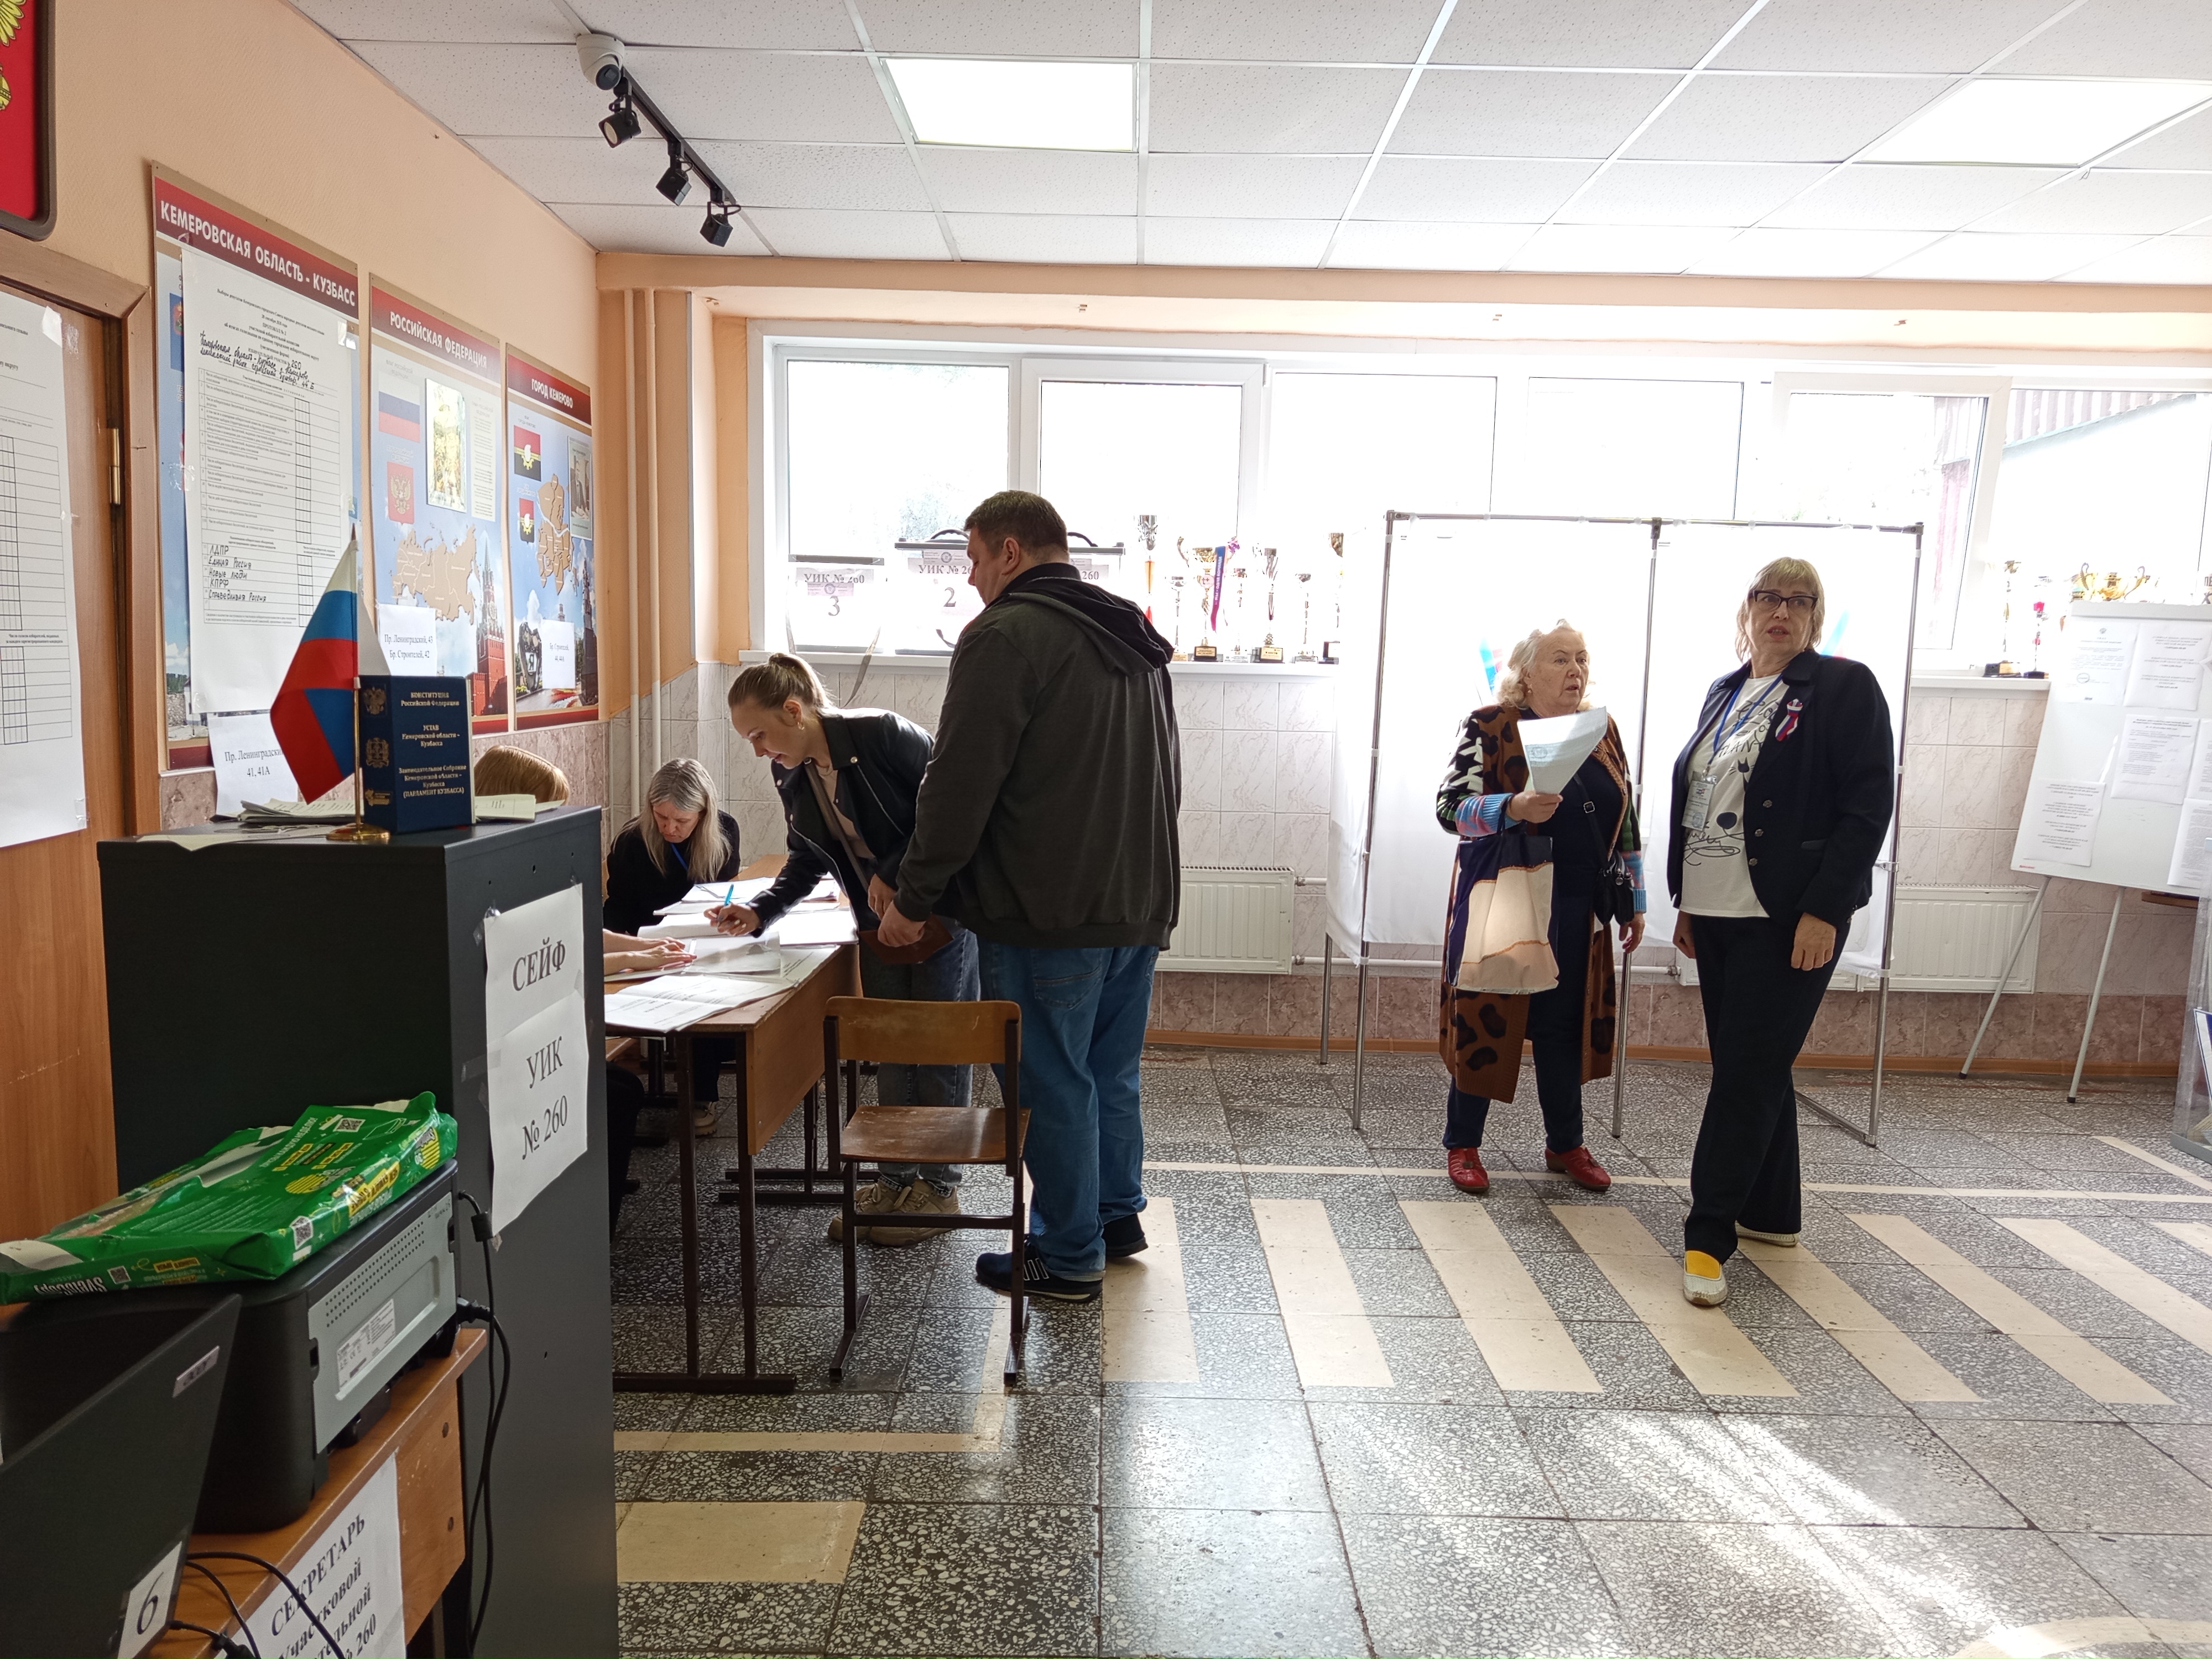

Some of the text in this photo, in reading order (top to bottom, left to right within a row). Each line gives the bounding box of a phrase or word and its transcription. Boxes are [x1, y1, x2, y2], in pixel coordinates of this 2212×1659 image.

[160, 200, 251, 259] КЕМЕРОВСКАЯ
[255, 246, 304, 283] ОБЛАСТЬ
[313, 273, 356, 307] КУЗБАСС
[389, 311, 487, 369] РОССИЙСКАЯ ФЕДЕРАЦИЯ
[531, 378, 573, 409] ГОРОД КЕМЕРОВО
[210, 545, 229, 556] ЛДПР
[804, 573, 830, 583] УИК
[832, 574, 844, 583] №
[919, 565, 945, 574] УИК
[947, 565, 959, 575] №
[1082, 571, 1099, 580] 260
[210, 578, 229, 588] КПРФ
[828, 596, 840, 616] 3
[943, 587, 956, 607] 2
[393, 634, 427, 645] Ленинградский,
[428, 635, 433, 644] 43
[398, 650, 424, 660] Строителей,
[224, 751, 237, 763] Пр.
[247, 766, 270, 778] 41, 41А
[512, 936, 566, 992] СЕЙФ
[526, 1036, 564, 1089] УИК
[522, 1095, 568, 1160] № 260
[272, 1514, 365, 1636] СЕКРЕТАРЬ
[136, 1572, 164, 1635] 6
[356, 1614, 376, 1656] 260
